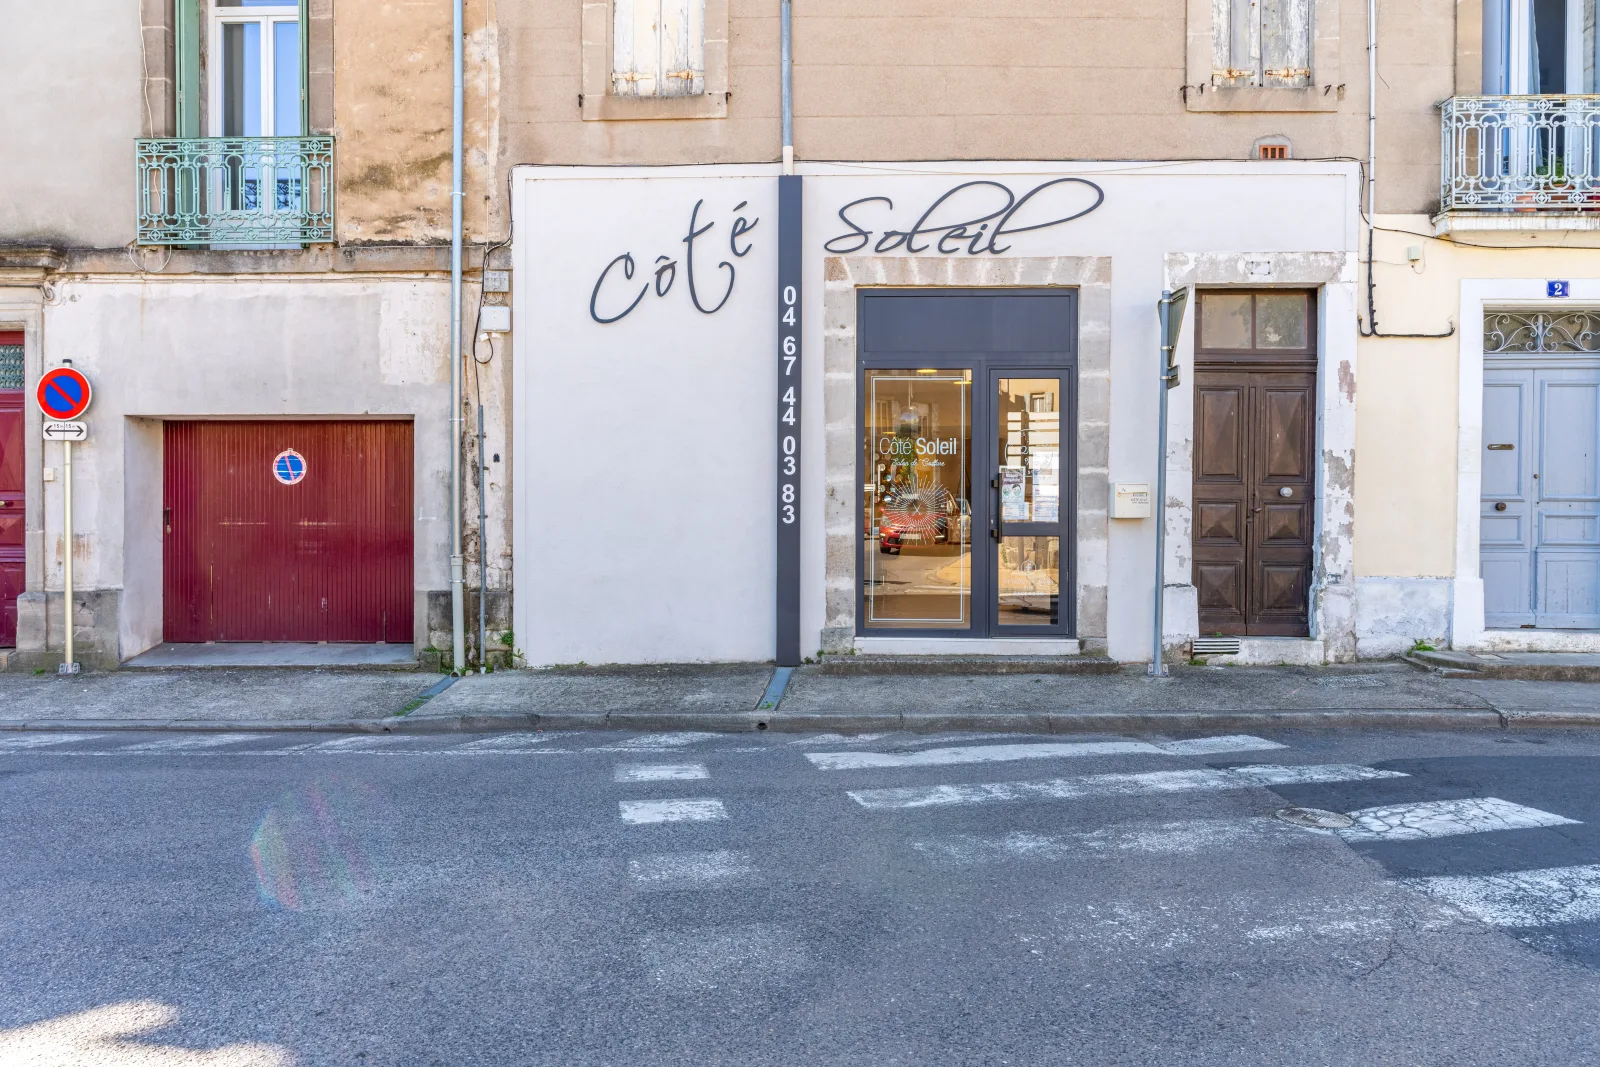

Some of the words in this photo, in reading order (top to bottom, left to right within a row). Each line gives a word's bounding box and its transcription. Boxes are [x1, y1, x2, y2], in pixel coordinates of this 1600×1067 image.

[589, 198, 759, 324] Côté
[824, 177, 1105, 255] Soleil
[782, 285, 797, 326] 04
[1554, 282, 1563, 295] 2
[782, 336, 797, 376] 67
[782, 386, 797, 425] 44
[782, 435, 797, 475] 03
[880, 436, 912, 455] Côté
[916, 437, 957, 455] Soleil
[781, 483, 796, 524] 83
